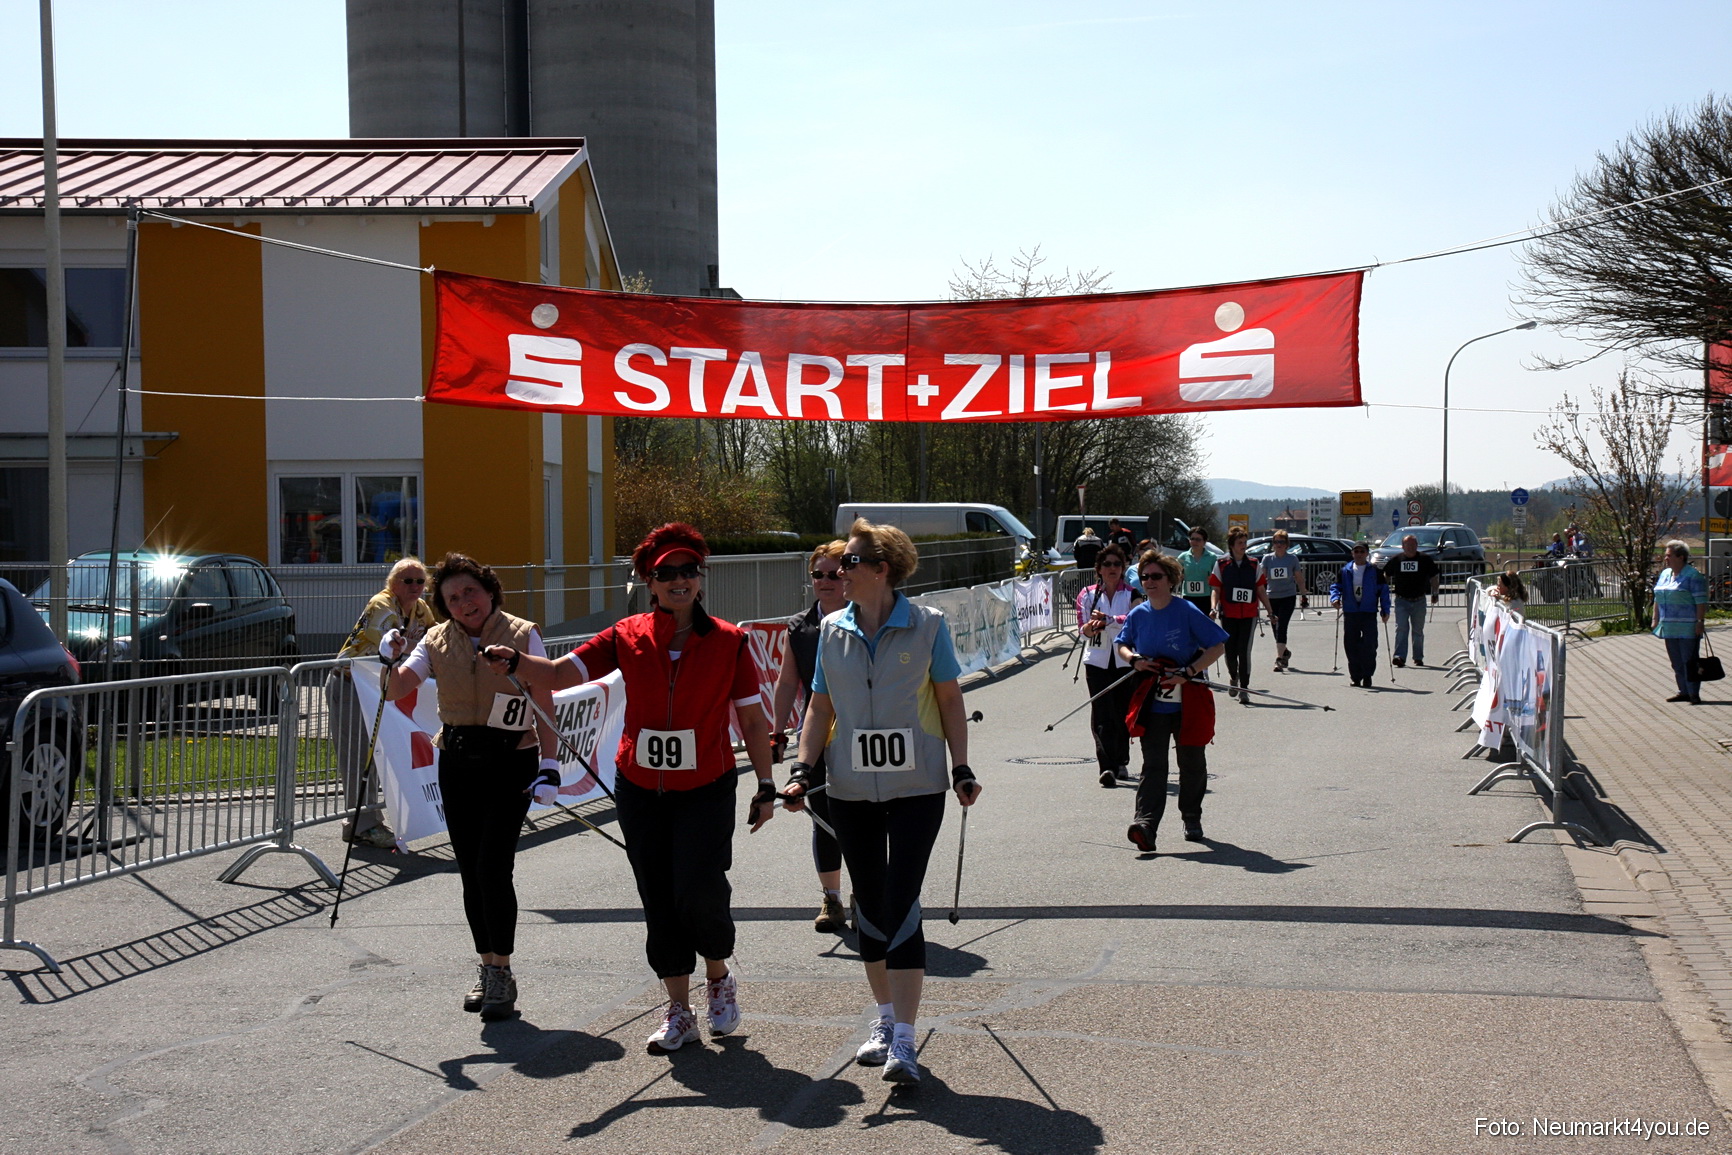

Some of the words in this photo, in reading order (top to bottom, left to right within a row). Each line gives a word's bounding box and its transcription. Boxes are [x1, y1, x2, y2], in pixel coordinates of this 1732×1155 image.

[1411, 504, 1420, 512] 60
[1402, 562, 1416, 571] 105
[1273, 568, 1285, 577] 82
[1189, 582, 1201, 592] 90
[1236, 590, 1249, 601] 86
[502, 698, 528, 726] 81
[647, 735, 682, 768] 99
[857, 732, 906, 768] 100
[422, 782, 440, 802] MIT
